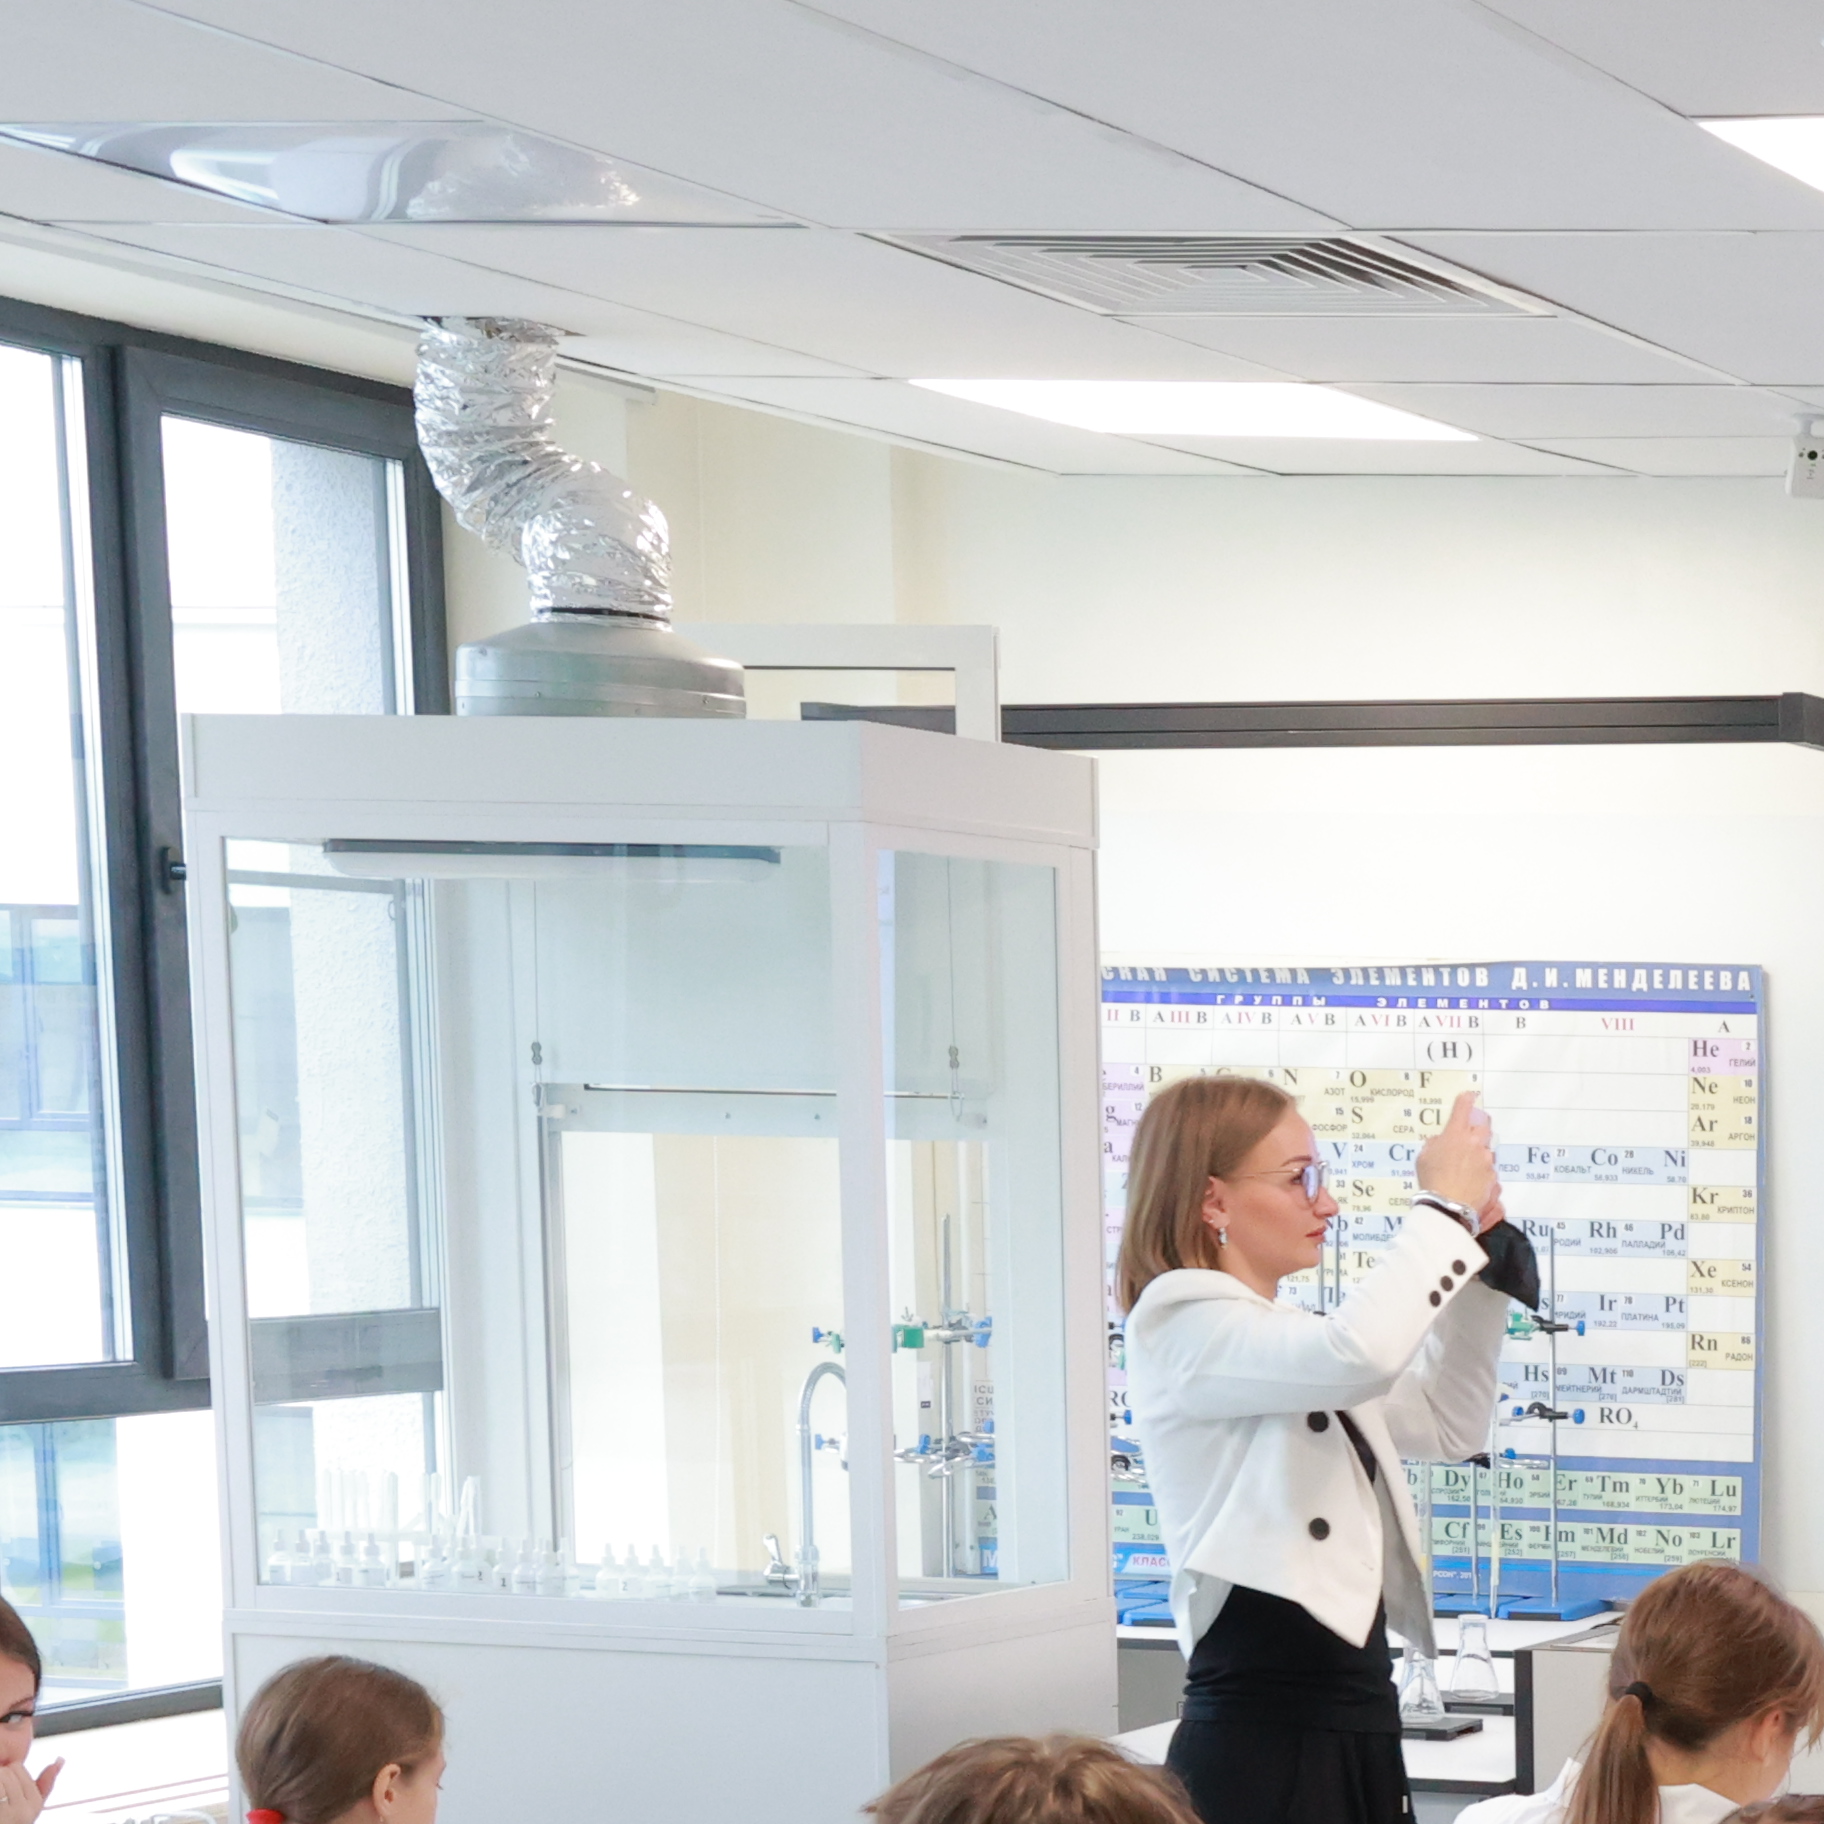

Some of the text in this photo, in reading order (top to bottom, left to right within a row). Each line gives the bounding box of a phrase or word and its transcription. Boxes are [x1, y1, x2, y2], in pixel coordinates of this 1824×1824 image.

[1187, 967, 1311, 985] СИСТЕМА
[1330, 967, 1489, 987] ЭЛЕМЕНТОВ
[1216, 995, 1550, 1010] ГРУППЫ ЭЛЕМЕНТОВ
[1171, 1011, 1190, 1023] III
[1372, 1014, 1390, 1027] VI
[1436, 1016, 1461, 1028] VII
[1602, 1018, 1634, 1030] VIII
[1692, 1040, 1719, 1057] He
[1729, 1058, 1756, 1067] ГЕЛИЙ
[1150, 1066, 1432, 1088] B N O F
[1692, 1077, 1718, 1094] Ne
[1370, 1088, 1414, 1098] КИСЛОРОД
[1733, 1096, 1755, 1104] НЕОН
[1352, 1106, 1441, 1126] S Cl
[1691, 1115, 1718, 1132] Ar
[1728, 1133, 1755, 1141] АРГОН
[1389, 1144, 1415, 1162] Cr
[1527, 1147, 1550, 1164] Fe
[1591, 1148, 1618, 1166] Co
[1664, 1150, 1686, 1167] Ni
[1554, 1165, 1592, 1173] КОБАЛЬТ
[1622, 1166, 1654, 1175] НИКЕЛЬ
[1352, 1180, 1375, 1197] Se
[1692, 1187, 1719, 1204] Kr
[1718, 1206, 1754, 1214] КРИПТОН
[1522, 1219, 1549, 1237] Ru
[1590, 1221, 1617, 1239] Rh
[1660, 1223, 1685, 1240] Pd
[1554, 1237, 1581, 1247] РОДИЙ
[1622, 1240, 1665, 1249] ПАЛЛАДИЙ
[1353, 1252, 1717, 1278] Te Xe
[1722, 1280, 1754, 1288] КСЕНОН
[1600, 1295, 1685, 1313] Ir Pt
[1621, 1313, 1659, 1322] ПЛАТИНА
[1690, 1333, 1718, 1351] Rn
[1725, 1352, 1753, 1361] РАДОН
[1524, 1365, 1684, 1386] Hs Mt Ds
[1445, 1470, 1470, 1491] Dy
[1597, 1475, 1630, 1493] Tm
[1656, 1478, 1683, 1495] Yb
[1710, 1480, 1737, 1497] Lu
[1445, 1521, 1470, 1539] Cf
[1501, 1523, 1522, 1541] Es
[1596, 1527, 1628, 1545] Md
[1656, 1529, 1682, 1547] No
[1712, 1532, 1736, 1549] Lr
